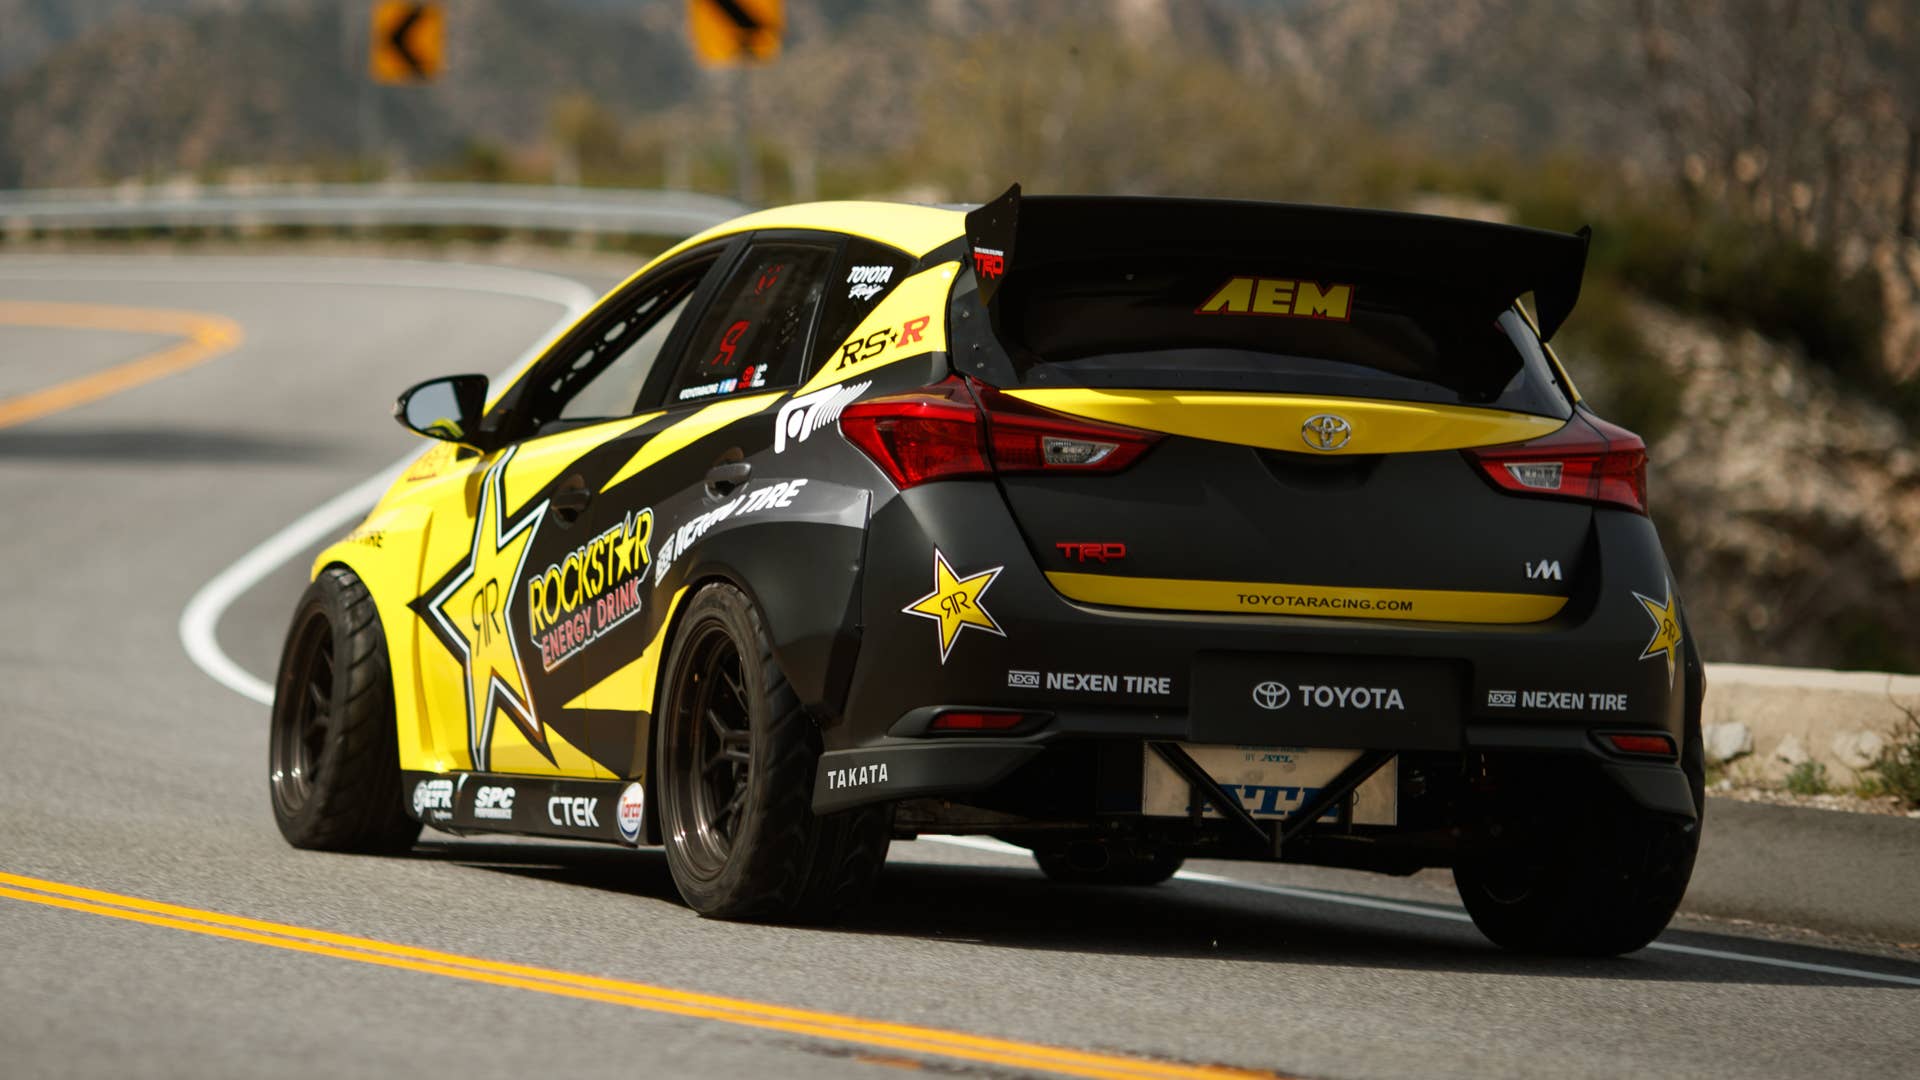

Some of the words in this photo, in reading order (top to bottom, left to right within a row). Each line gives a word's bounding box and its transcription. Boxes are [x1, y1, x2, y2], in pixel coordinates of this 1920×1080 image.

[847, 266, 893, 283] TOYOTA
[974, 253, 1004, 280] TRD
[1195, 277, 1353, 321] AEM
[746, 478, 808, 513] TIRE
[1056, 543, 1126, 563] TRD
[1525, 559, 1562, 580] iM
[1237, 593, 1413, 612] TOYOTARACING.COM
[541, 605, 592, 665] ENERGY
[597, 576, 640, 626] DRINK
[1046, 672, 1118, 693] NEXEN
[1123, 675, 1171, 695] TIRE
[1298, 685, 1405, 710] TOYOTA
[1522, 691, 1584, 710] NEXEN
[1588, 693, 1628, 711] TIRE
[827, 763, 888, 790] TAKATA
[474, 786, 516, 808] SPC
[548, 796, 600, 828] CTEK
